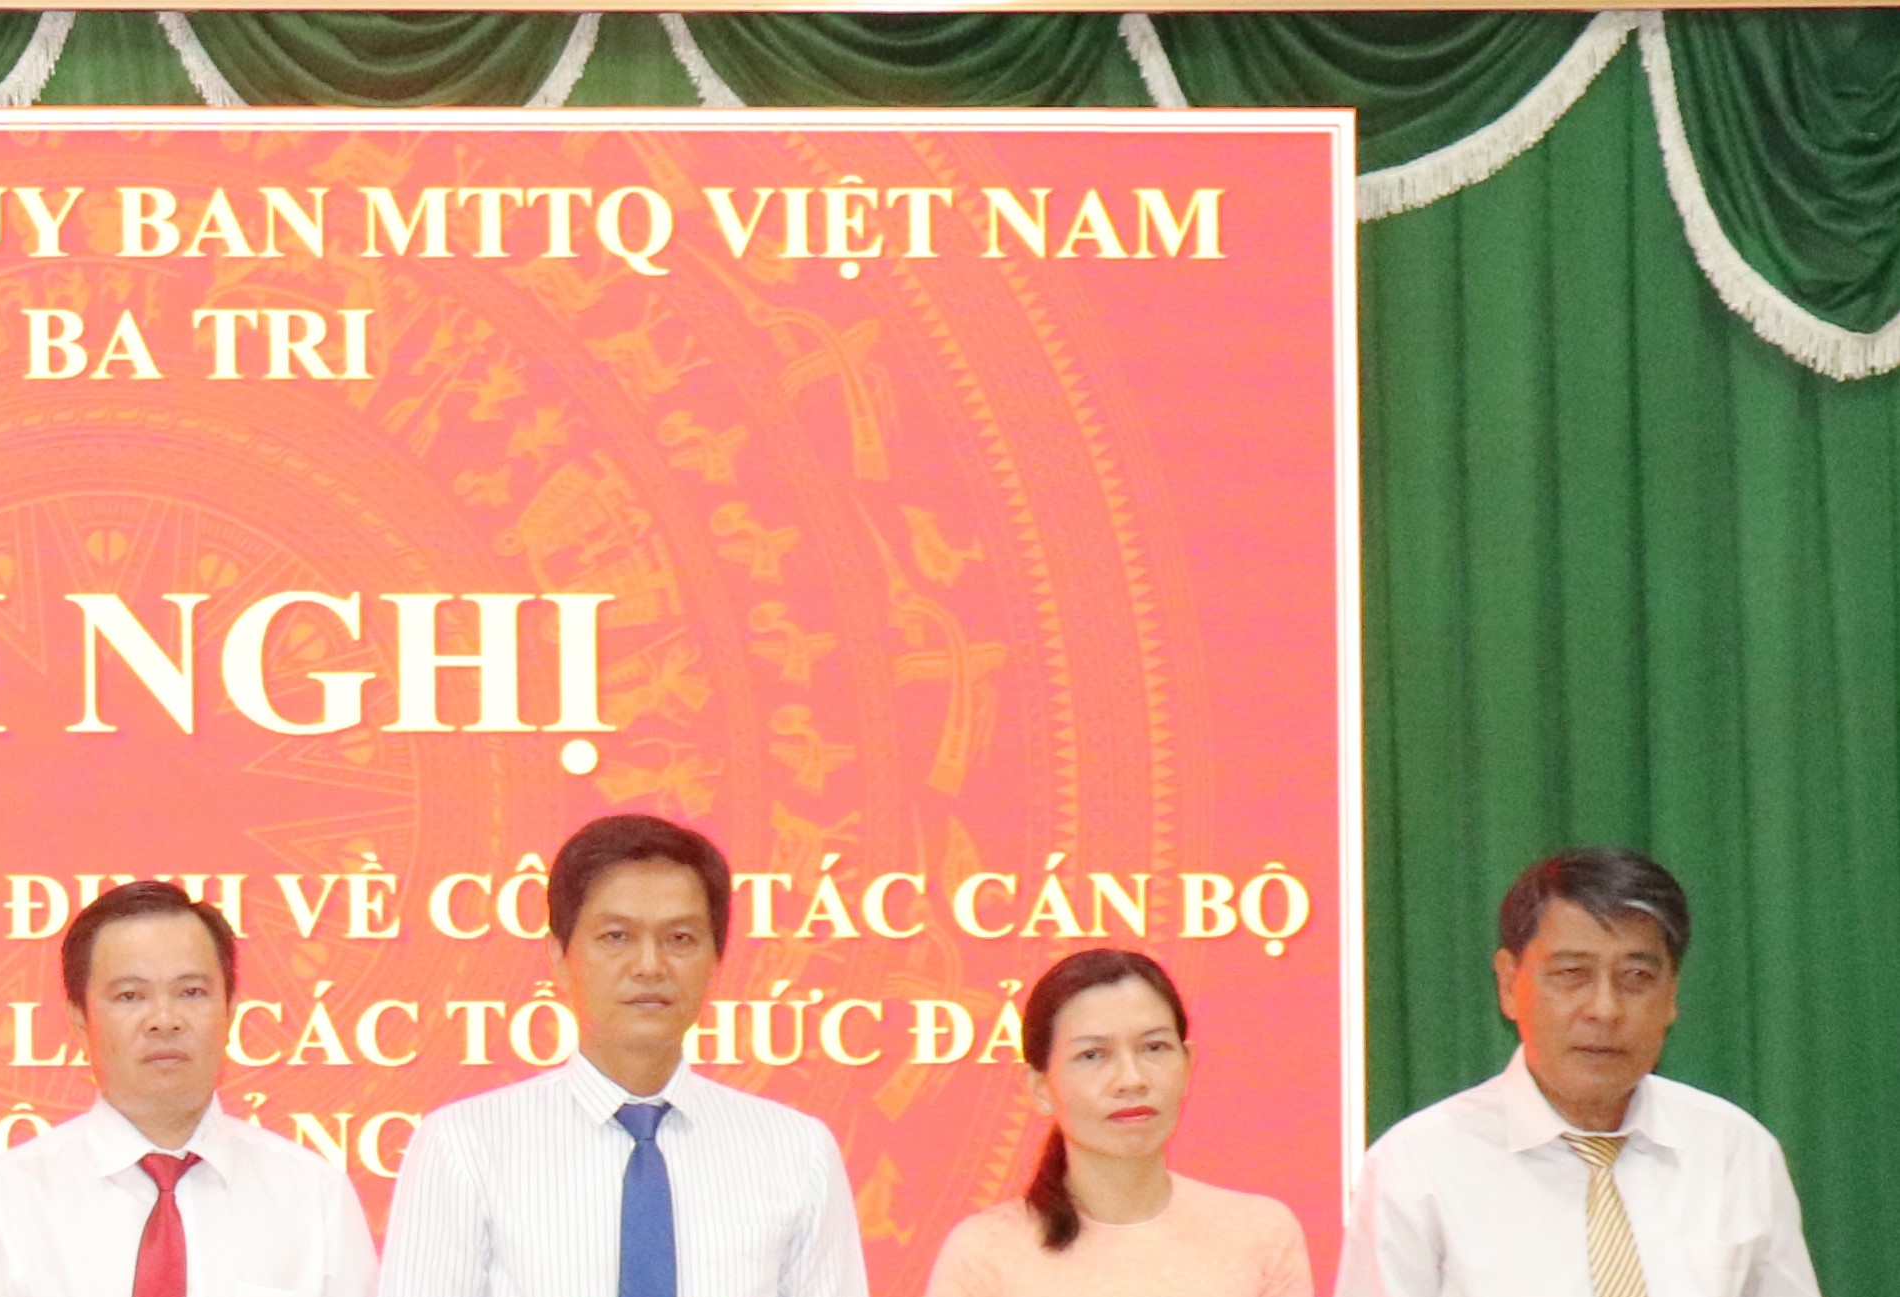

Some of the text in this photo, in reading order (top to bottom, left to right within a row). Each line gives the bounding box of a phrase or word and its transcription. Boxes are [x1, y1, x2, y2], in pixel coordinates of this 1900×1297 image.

[117, 187, 328, 259] BAN
[359, 187, 672, 276] MTTQ
[703, 174, 952, 280] VIỆT
[982, 187, 1224, 259] NAM
[22, 308, 162, 380] BA
[193, 308, 374, 380] TRI
[65, 591, 616, 775] NGHỊ
[276, 852, 400, 939] VỀ
[428, 853, 551, 940] CÔ
[732, 853, 924, 939] TÁC
[953, 853, 1150, 939] CÁN
[1180, 861, 1309, 958] BỘ
[226, 981, 418, 1067] CÁC
[446, 981, 580, 1067] TỔ
[683, 980, 882, 1066] HỨC
[907, 978, 1025, 1066] ĐẢ
